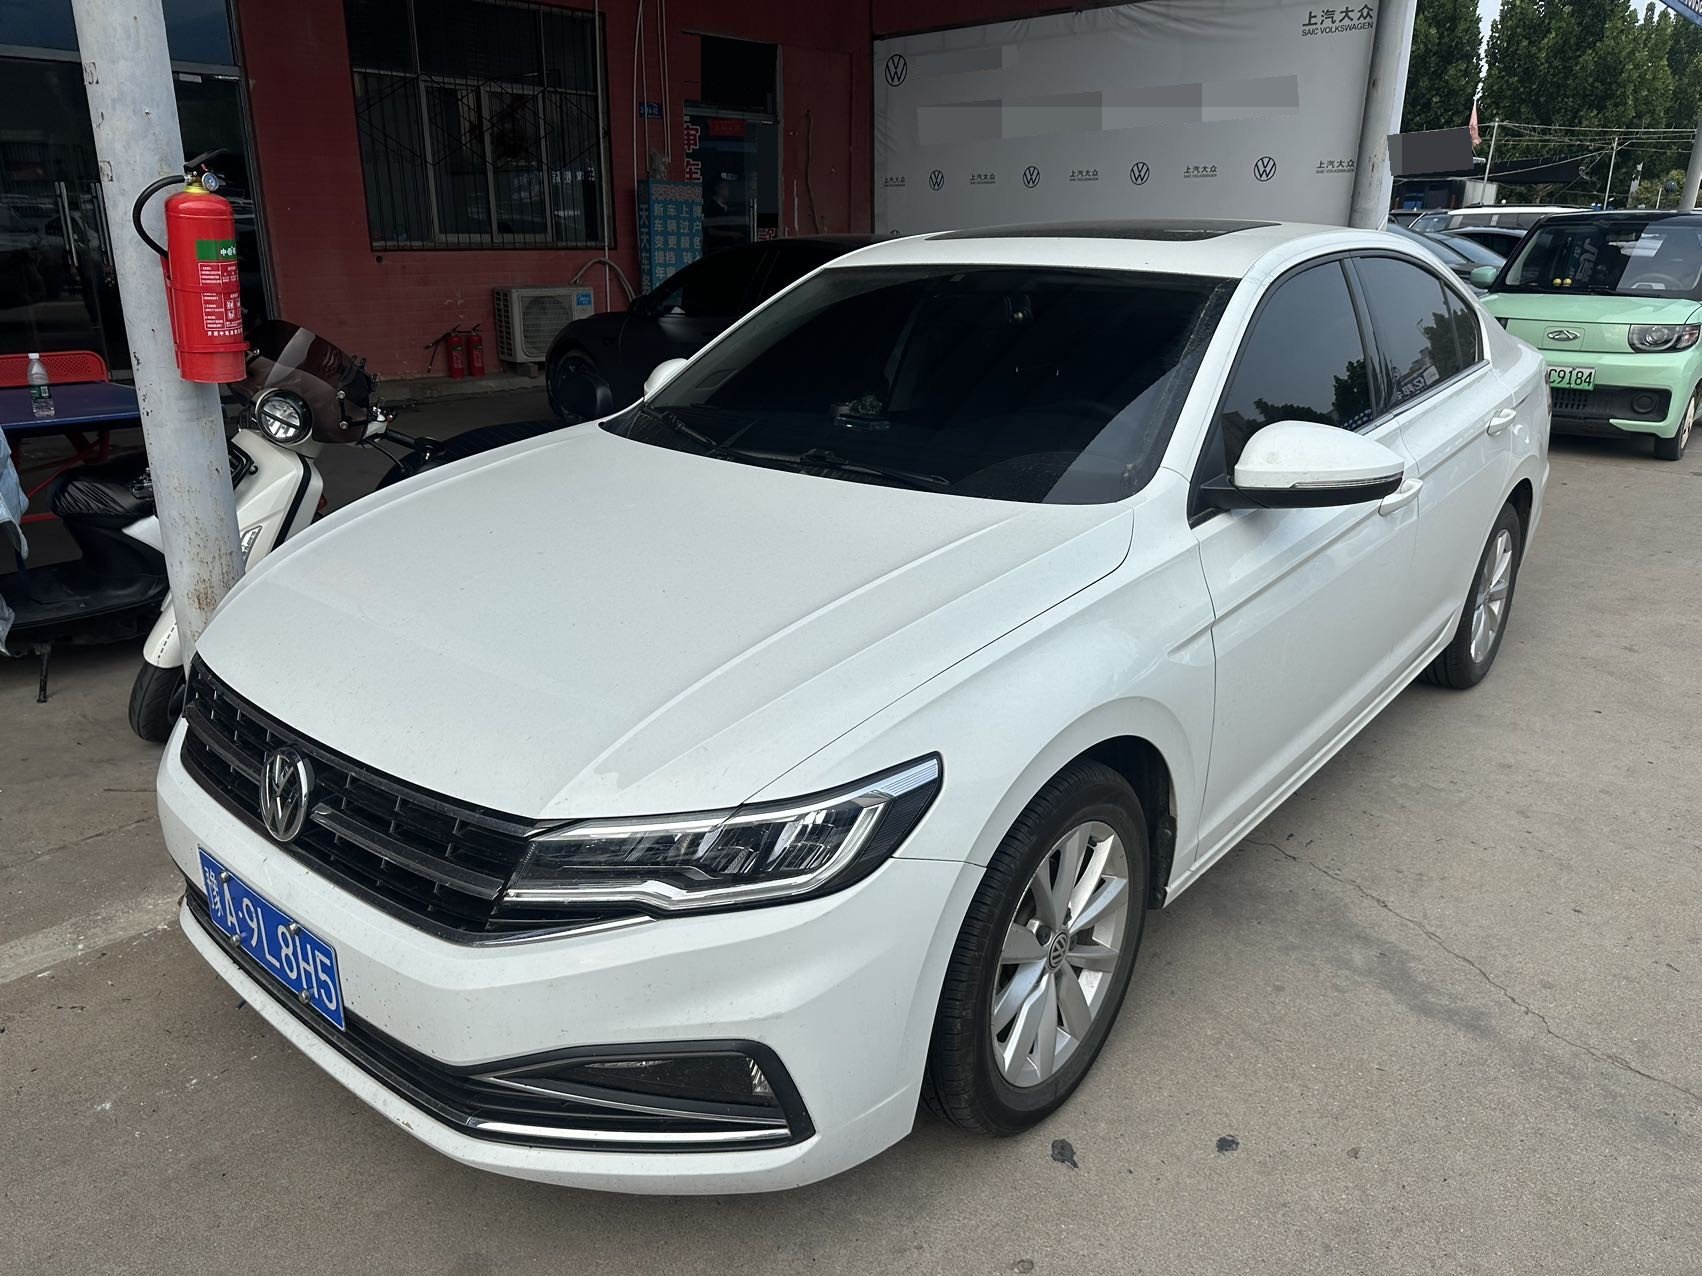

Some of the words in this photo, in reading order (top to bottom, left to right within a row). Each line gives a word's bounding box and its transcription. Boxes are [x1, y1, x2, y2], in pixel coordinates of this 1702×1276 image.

[1302, 4, 1374, 27] 上汽大众
[1301, 27, 1319, 37] SAIC
[1320, 22, 1374, 34] VOLKSWAGEN
[1184, 165, 1217, 174] 上汽大众
[1316, 159, 1355, 169] 上汽大众
[1069, 169, 1099, 178] 上汽大众
[1548, 368, 1593, 387] C9184
